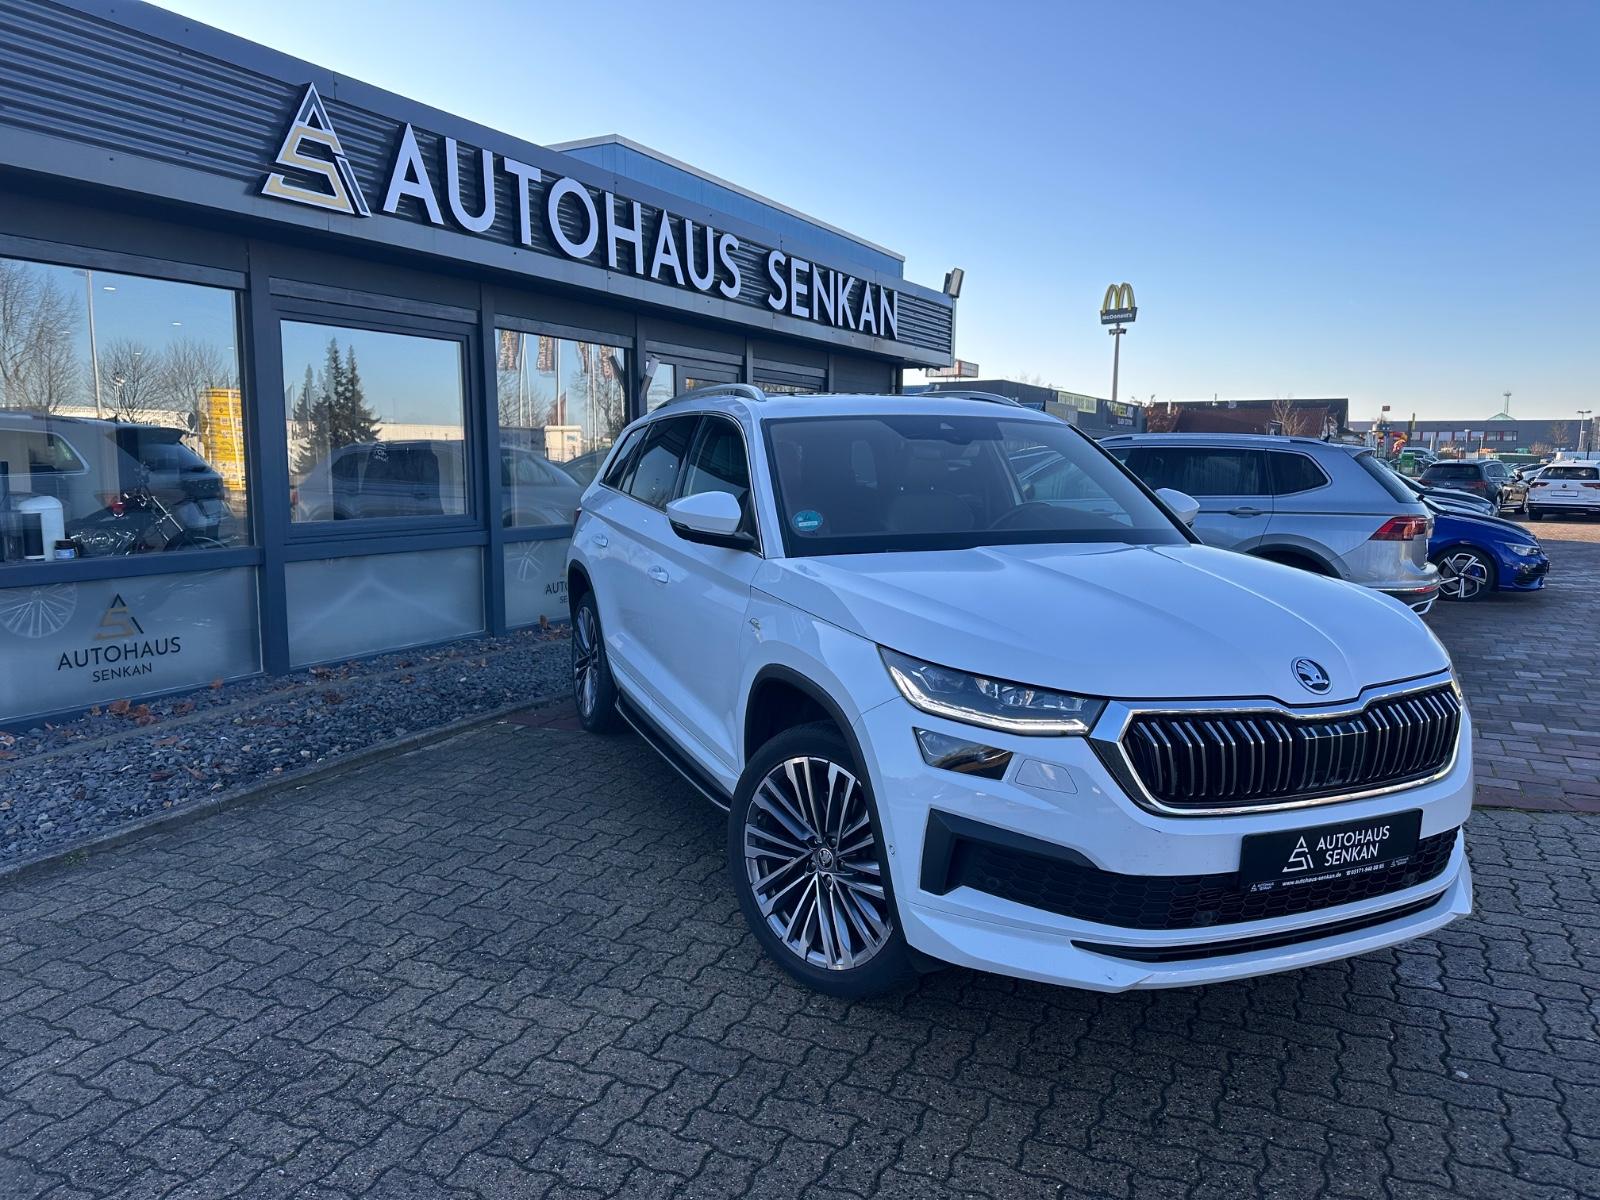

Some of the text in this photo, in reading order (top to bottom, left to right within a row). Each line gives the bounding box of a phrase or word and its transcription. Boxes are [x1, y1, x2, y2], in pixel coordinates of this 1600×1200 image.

[382, 122, 742, 299] AUTOHAUS
[767, 250, 898, 340] SENKAN
[57, 636, 181, 671] AUTOHAUS
[92, 662, 152, 683] SENKAN
[1316, 825, 1390, 852] AUTOHAUS
[1324, 843, 1379, 867] SENKAN
